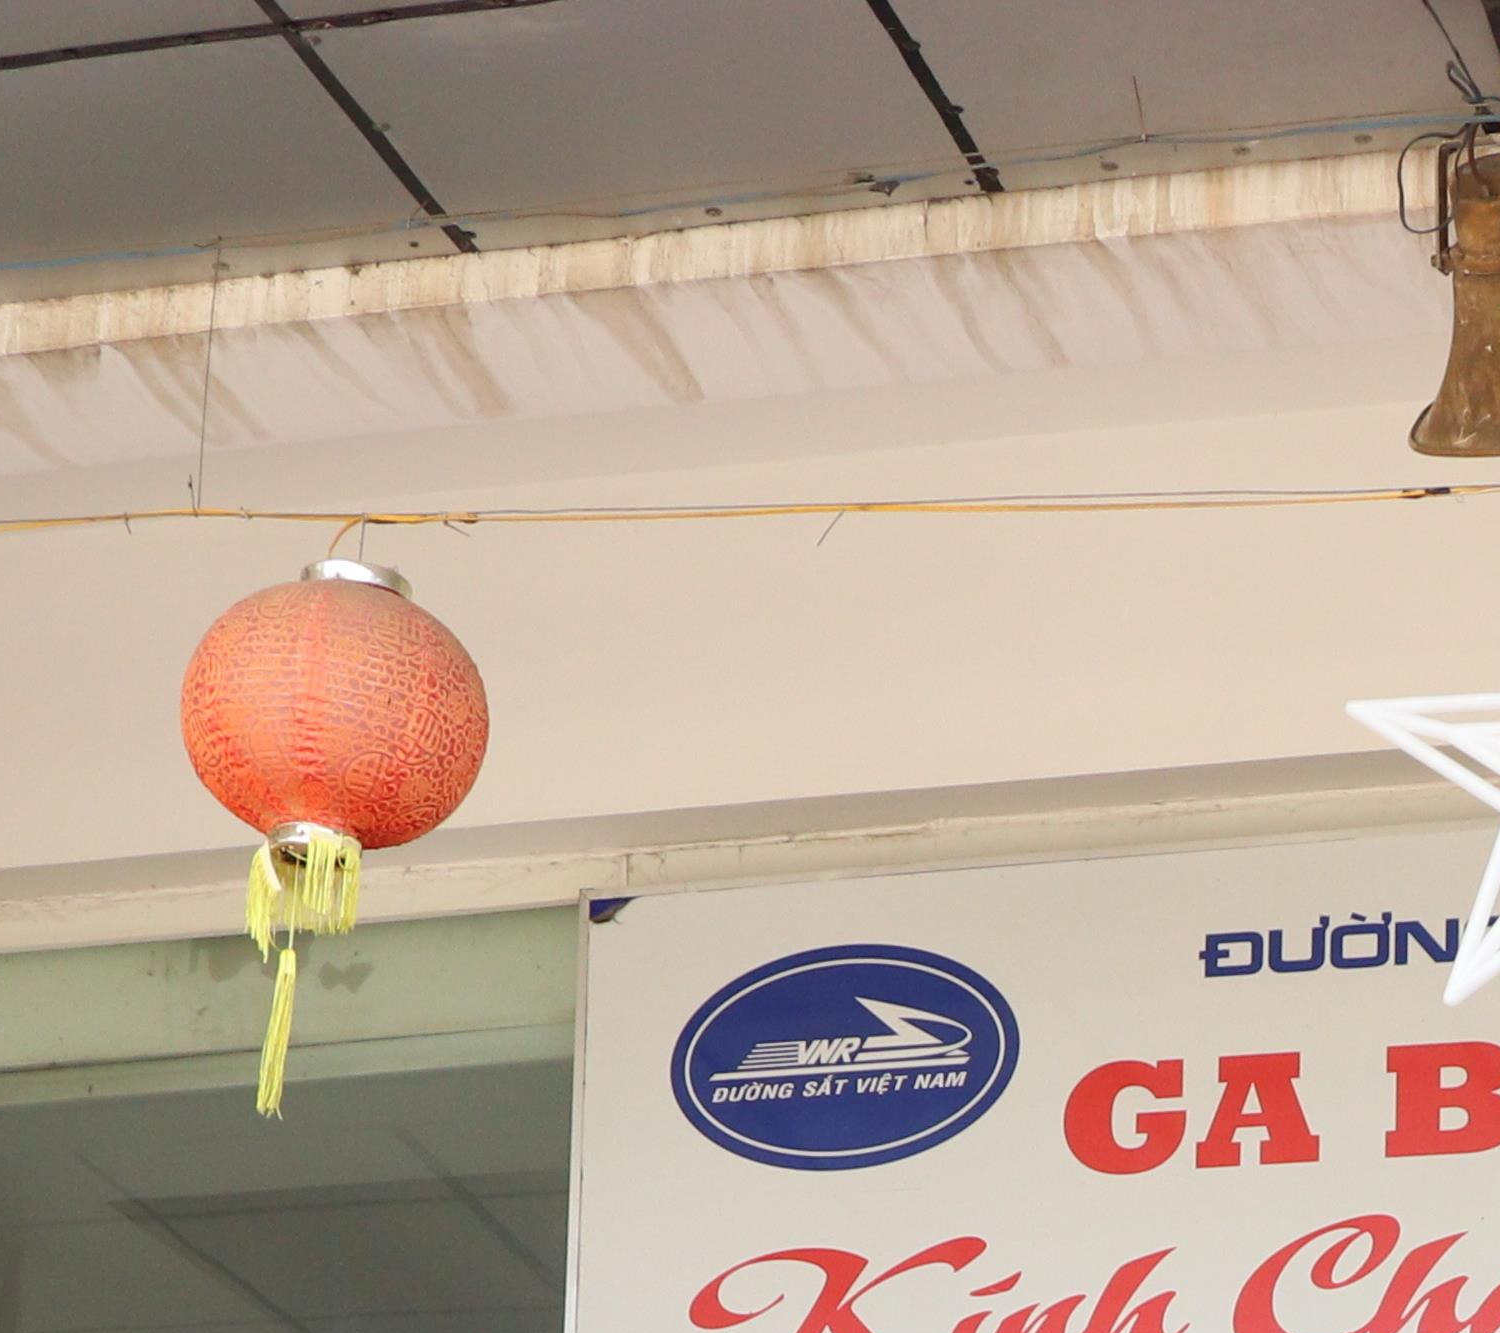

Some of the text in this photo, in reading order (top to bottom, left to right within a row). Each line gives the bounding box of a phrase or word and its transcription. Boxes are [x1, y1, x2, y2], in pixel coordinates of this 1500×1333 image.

[712, 1071, 967, 1103] ĐƯỜNG SẮT VIỆT NAM
[1063, 1056, 1318, 1176] GA
